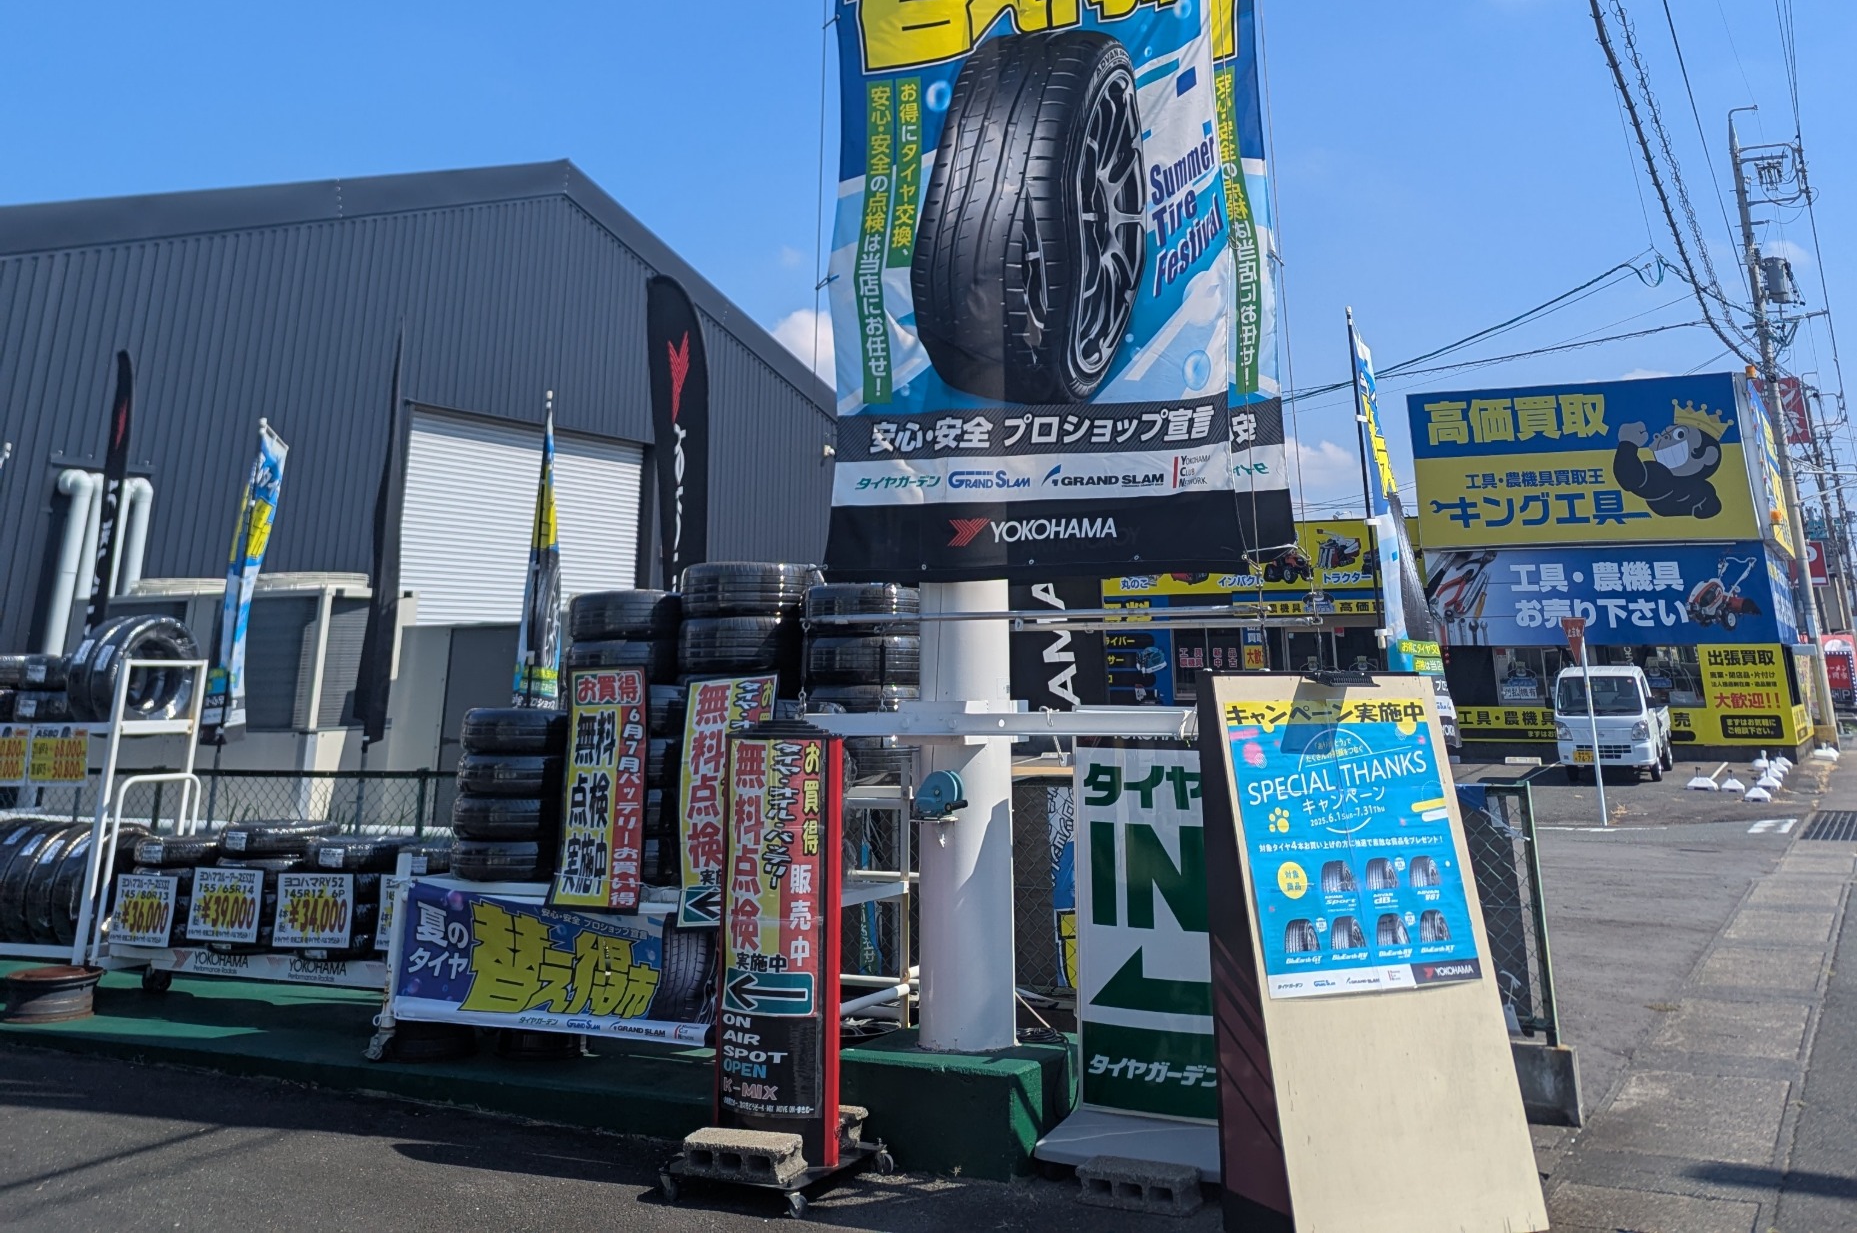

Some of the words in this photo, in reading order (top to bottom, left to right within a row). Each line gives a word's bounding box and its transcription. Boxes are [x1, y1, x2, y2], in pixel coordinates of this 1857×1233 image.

[1150, 133, 1215, 206] Summer
[1152, 189, 1198, 248] Tire
[1153, 193, 1224, 299] Festival
[1003, 404, 1215, 447] プロショップ宣言
[1424, 393, 1608, 446] 高価買取
[854, 474, 942, 491] タイヤガーデン
[996, 470, 1031, 489] SLAM
[1060, 475, 1120, 487] GRAND
[1121, 473, 1165, 485] SLAM
[1465, 468, 1606, 490] 工具・農機具買取王
[1432, 490, 1640, 529] キング工具
[990, 516, 1118, 544] YOKOHAMA
[1120, 579, 1149, 590] 丸のこ
[1510, 561, 1684, 592] 工具・農機具
[1515, 597, 1690, 629] お売り下さい
[1707, 650, 1776, 666] 出張買取
[576, 673, 640, 704] お買得
[1713, 692, 1781, 709] 大歓迎!!
[1226, 701, 1425, 726] キャンペーン実施中
[1458, 710, 1556, 726] 工具・農機具
[574, 709, 617, 767] 無料
[1083, 763, 1202, 811] タイヤ
[1247, 768, 1336, 806] SPECIAL
[1338, 750, 1428, 786] THANKS
[568, 772, 611, 830] 点検
[1302, 785, 1385, 816] キャンペーン
[730, 740, 767, 952] 無料点検
[561, 831, 608, 896] 実施中
[1091, 821, 1210, 932] IN
[120, 889, 169, 901] 145/80R13
[198, 883, 255, 895] 155/65R14
[283, 877, 345, 888] ヨコハマRY52
[284, 889, 324, 899] 145R12
[331, 889, 346, 899] 6P
[121, 900, 170, 935] ¥36,000
[201, 895, 256, 930] ¥39,000
[288, 898, 348, 934] ¥34,000
[416, 901, 469, 950] 夏の
[789, 863, 812, 967] 販売中
[193, 951, 249, 969] YOKOHAMA
[289, 957, 347, 976] YOKOHAMA
[407, 948, 469, 980] タイヤ
[458, 899, 661, 1019] 替え得市
[736, 952, 787, 973] 実施中
[1434, 965, 1474, 977] YOKOHAMA
[617, 1026, 645, 1034] GRAND
[644, 1028, 666, 1037] SLAM
[723, 1013, 751, 1028] ON
[723, 1029, 761, 1046] AIR
[723, 1045, 789, 1064] SPOT
[723, 1058, 767, 1079] OPEN
[1087, 1053, 1218, 1088] タイヤガーデン
[723, 1076, 779, 1101] K-MIX
